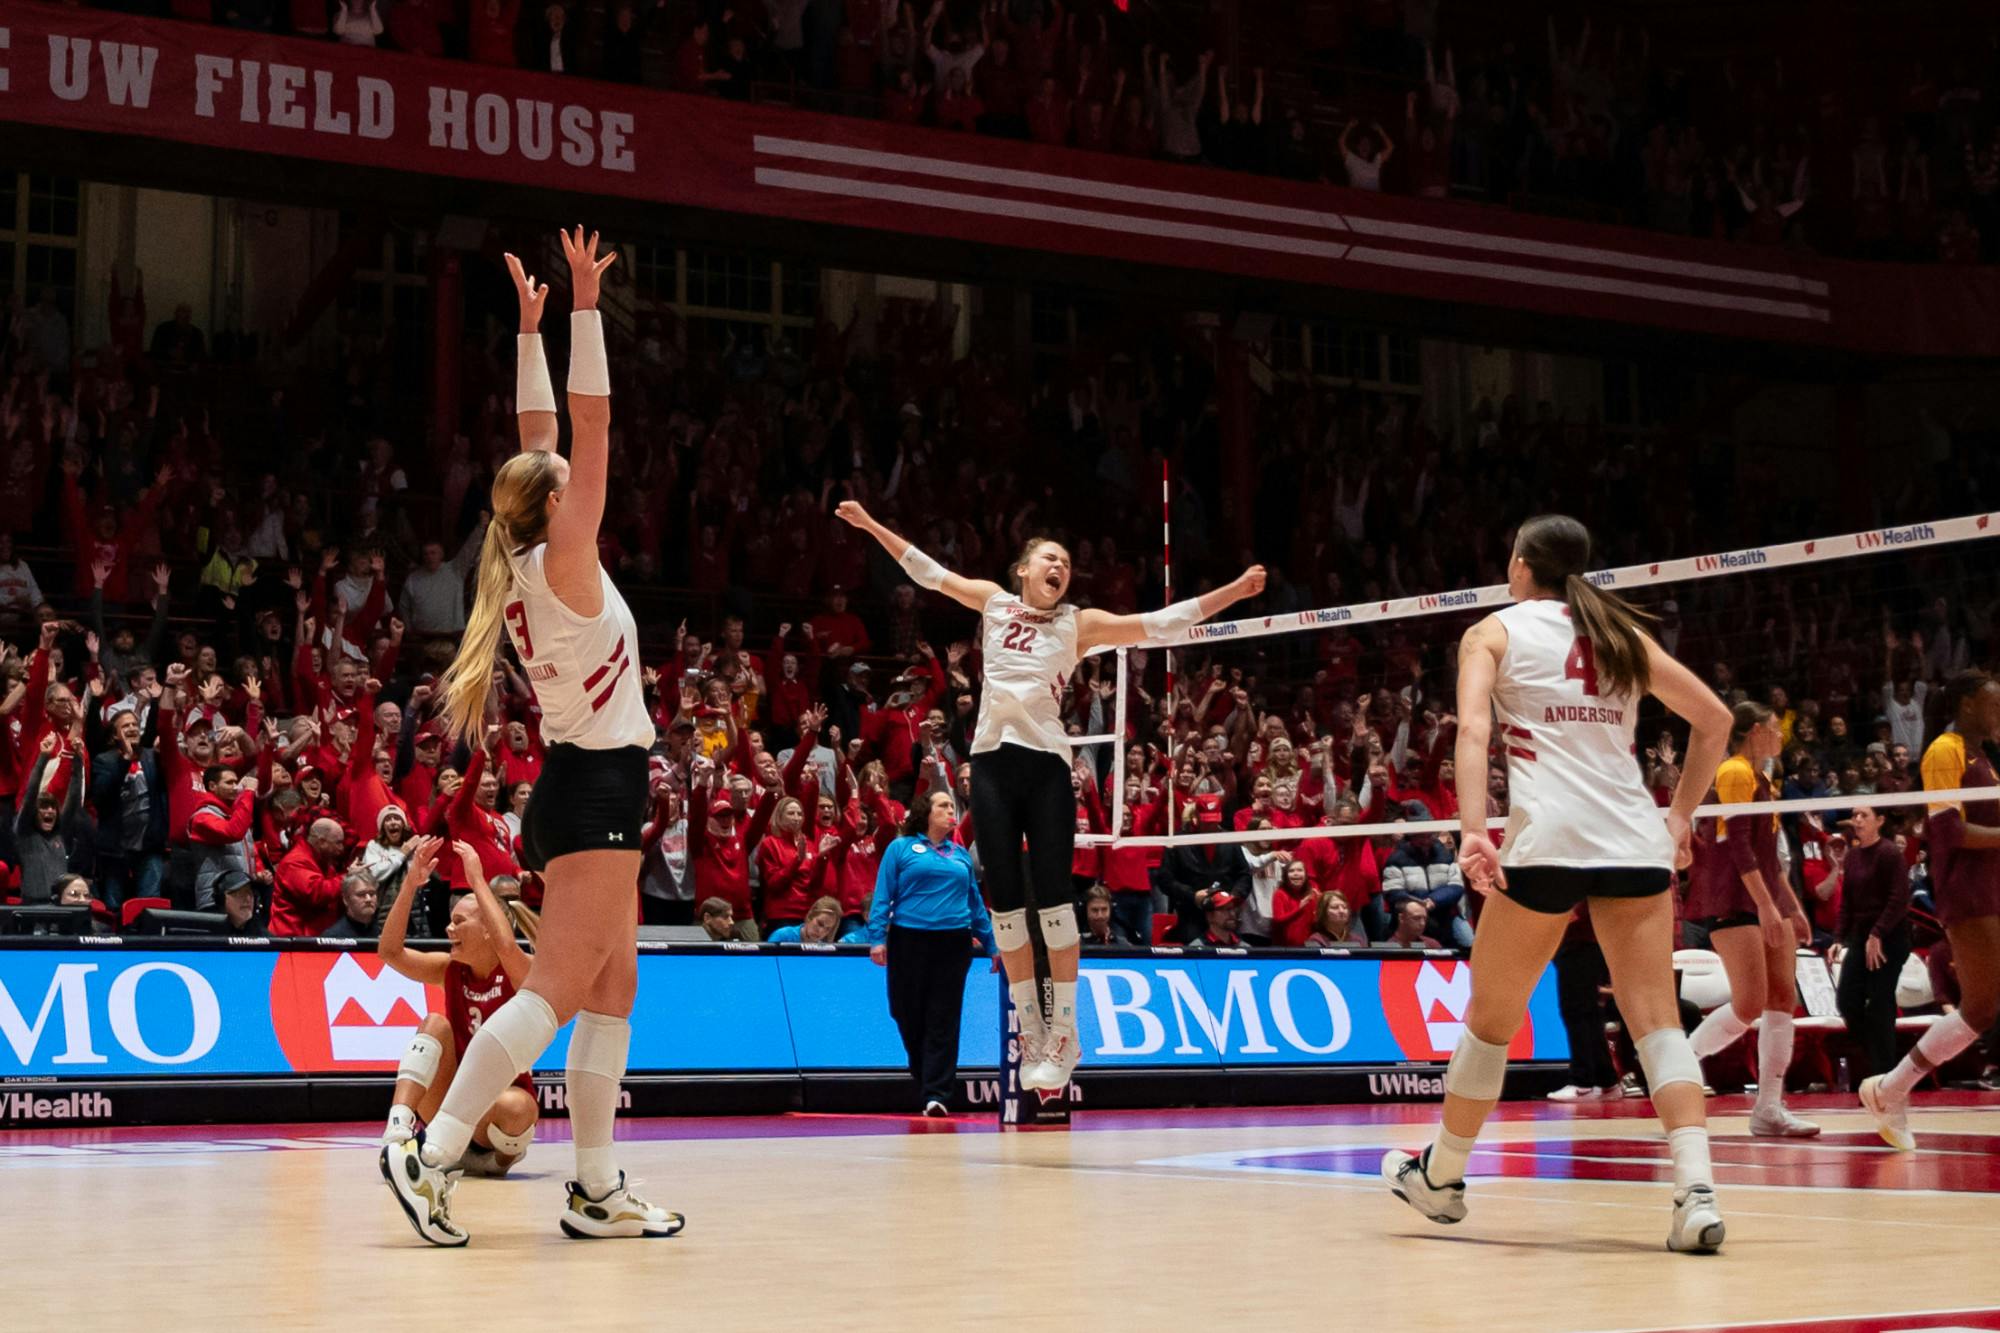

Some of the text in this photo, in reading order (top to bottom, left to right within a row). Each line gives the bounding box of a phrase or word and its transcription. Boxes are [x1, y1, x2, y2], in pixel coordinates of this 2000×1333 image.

[48, 35, 159, 108] UW
[195, 54, 394, 139] FIELD
[428, 86, 636, 172] HOUSE
[1003, 622, 1037, 653] 22
[1564, 636, 1600, 697] 4
[1544, 705, 1624, 726] ANDERSON
[0, 961, 221, 1066] MO
[1078, 968, 1351, 1056] BMO
[0, 1092, 112, 1118] Health
[1368, 1073, 1447, 1096] UWHeal
